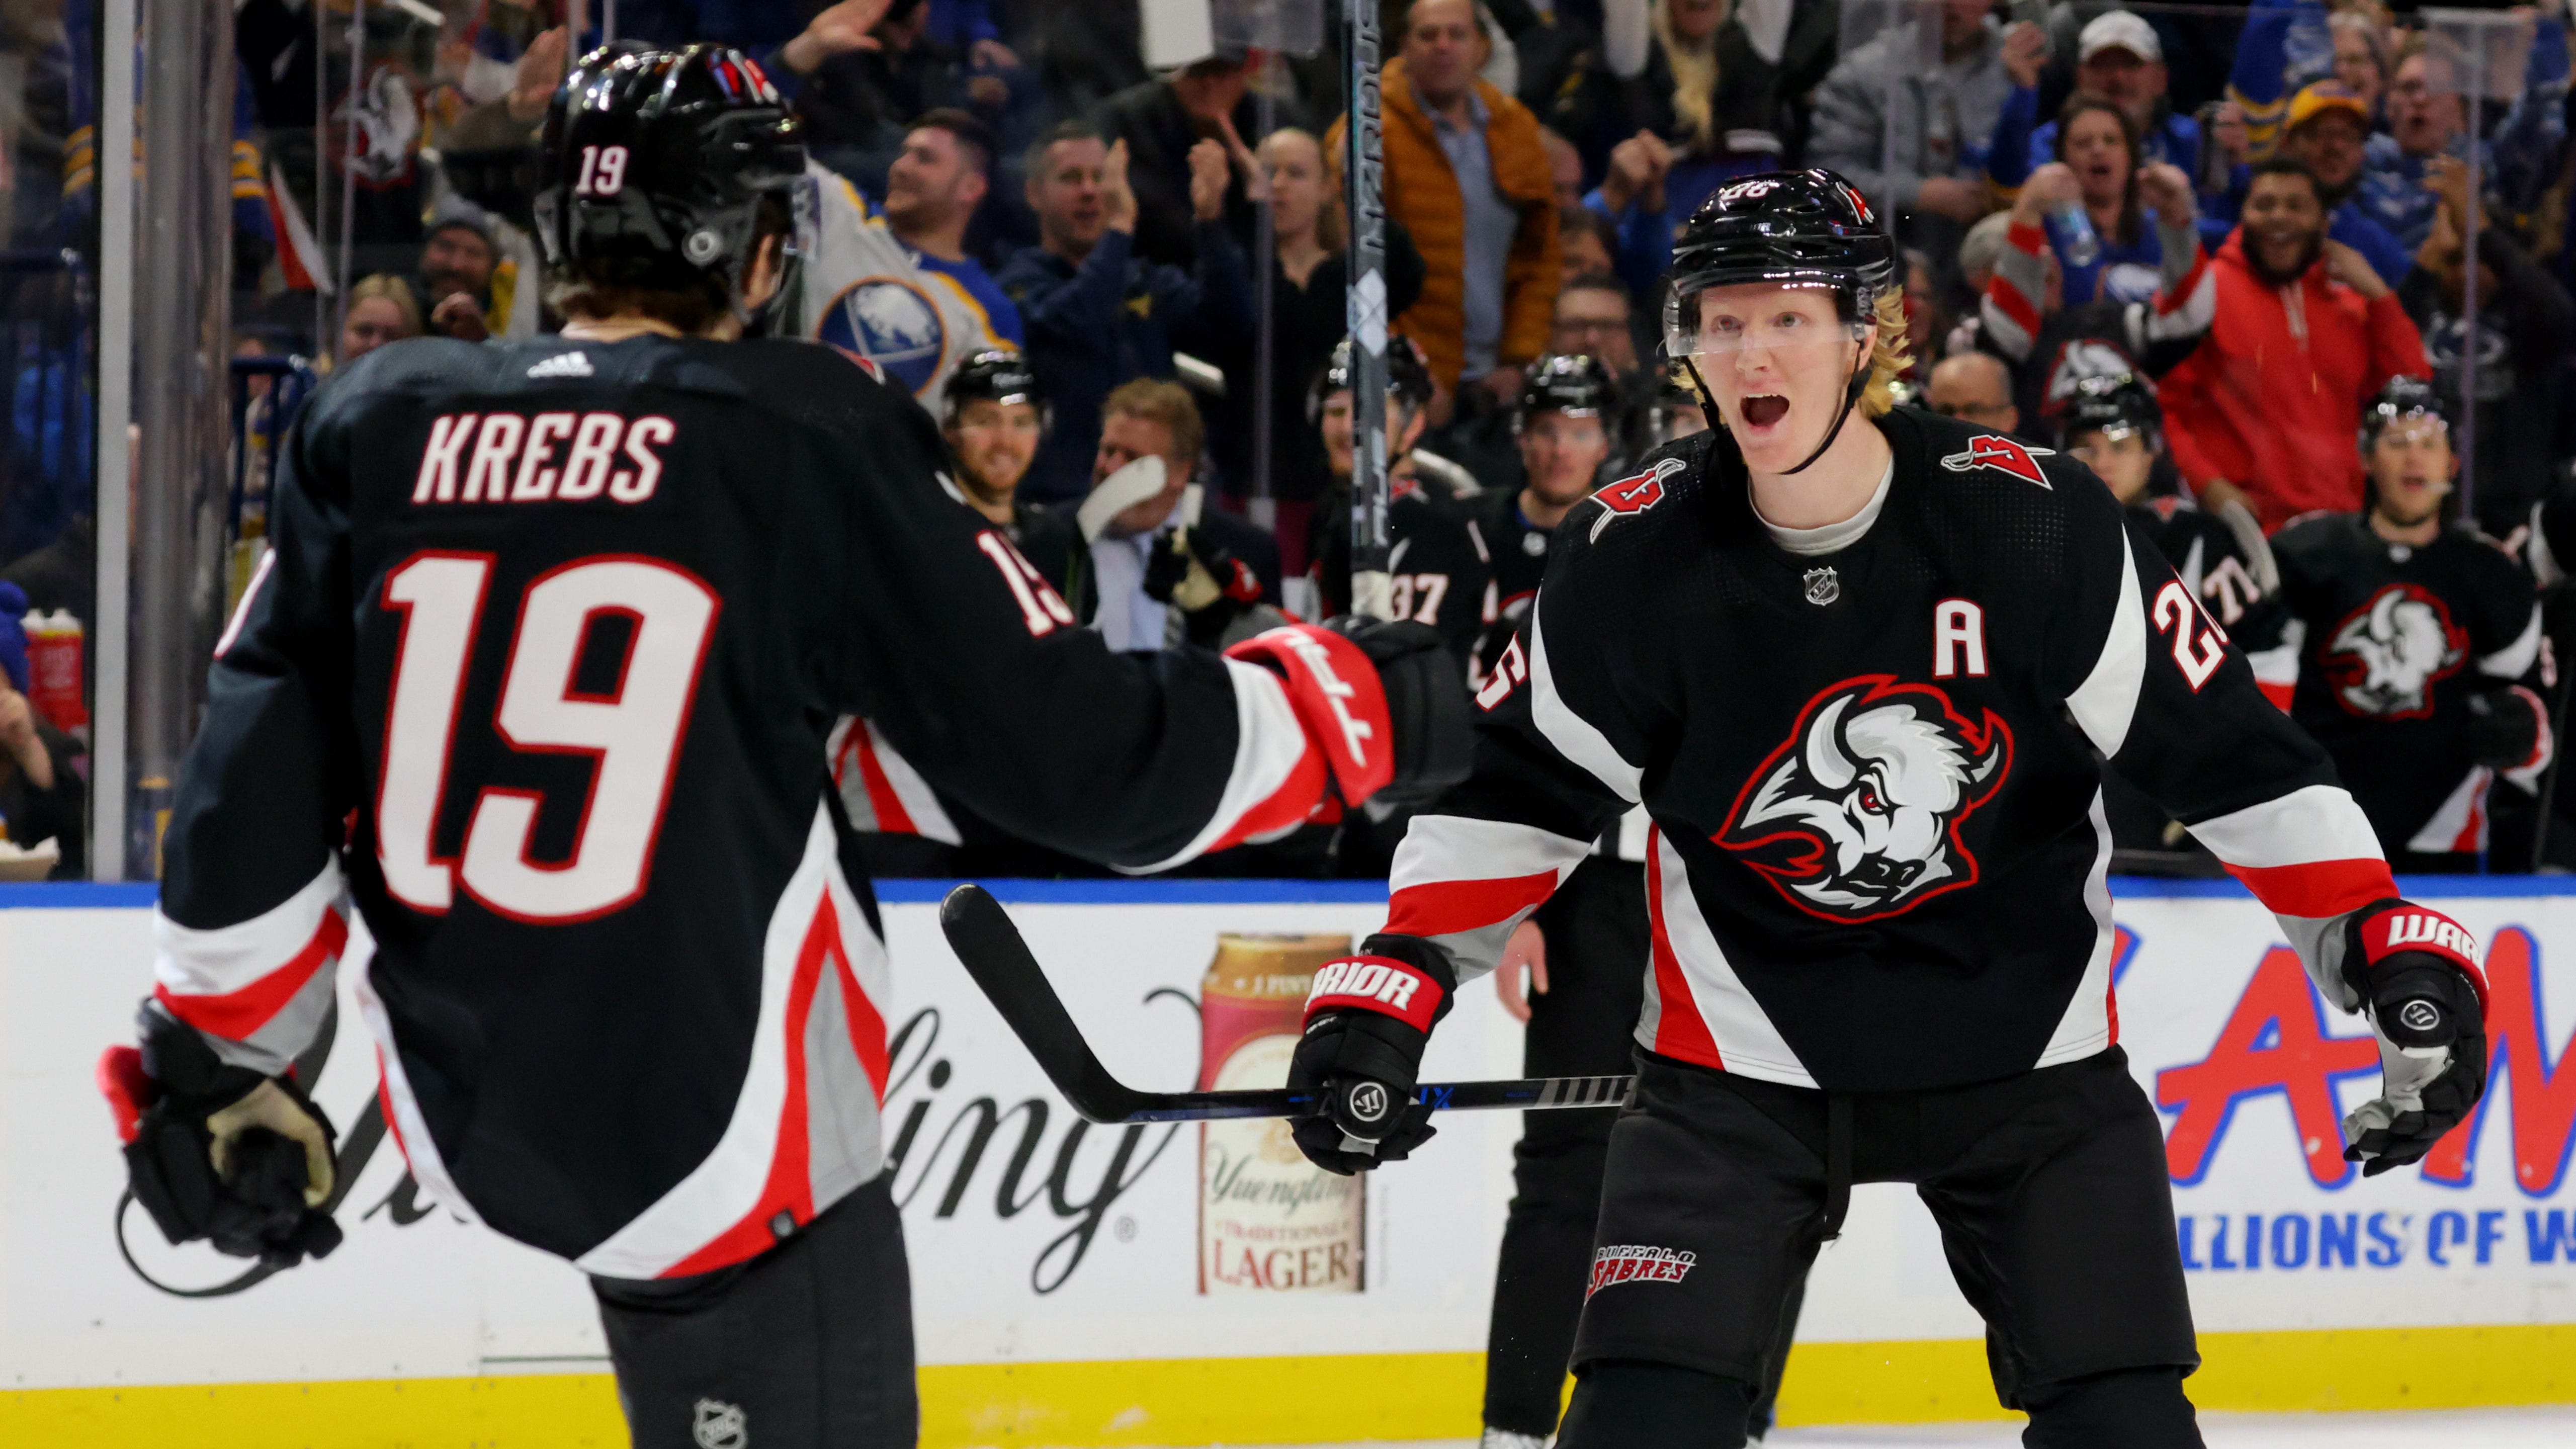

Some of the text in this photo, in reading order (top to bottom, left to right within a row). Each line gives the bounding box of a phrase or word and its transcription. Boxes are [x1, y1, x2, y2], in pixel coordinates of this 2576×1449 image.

[575, 144, 629, 196] 19
[412, 411, 676, 503] KREBS
[1932, 596, 1989, 679] A
[2151, 564, 2229, 695] 2
[375, 548, 724, 925] 19
[1214, 1239, 1349, 1290] LAGER
[1596, 1244, 1697, 1264] BUFFALO
[2428, 1209, 2505, 1266] OF
[1584, 1257, 1693, 1307] SABRES
